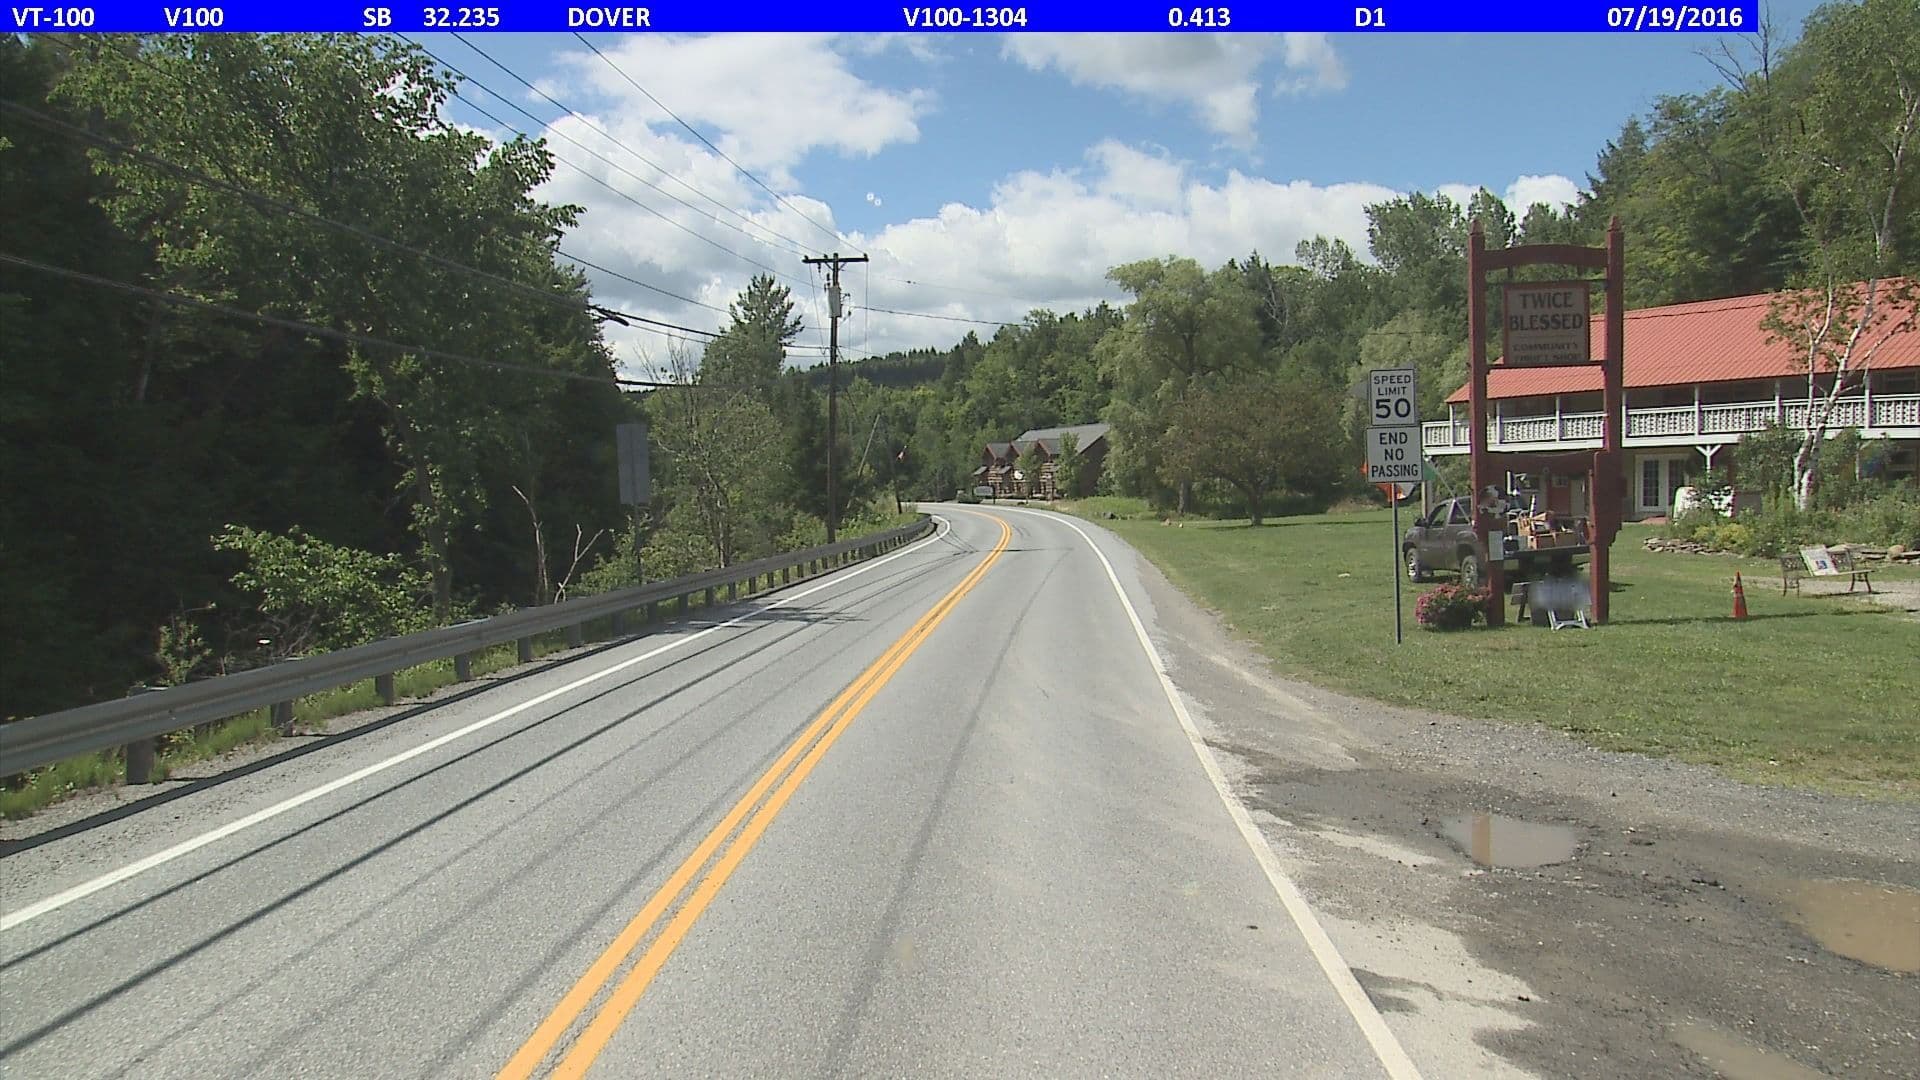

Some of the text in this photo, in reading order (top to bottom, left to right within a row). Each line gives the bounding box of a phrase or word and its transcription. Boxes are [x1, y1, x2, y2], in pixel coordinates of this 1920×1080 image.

[1520, 292, 1573, 309] TWICE
[1509, 314, 1583, 331] BLESSED
[1373, 375, 1411, 385] SPEED
[1377, 387, 1407, 396] LIMIT
[1375, 398, 1411, 418] 50
[1379, 432, 1408, 445] END
[1384, 448, 1404, 460] NO
[1371, 464, 1418, 477] PASSING
